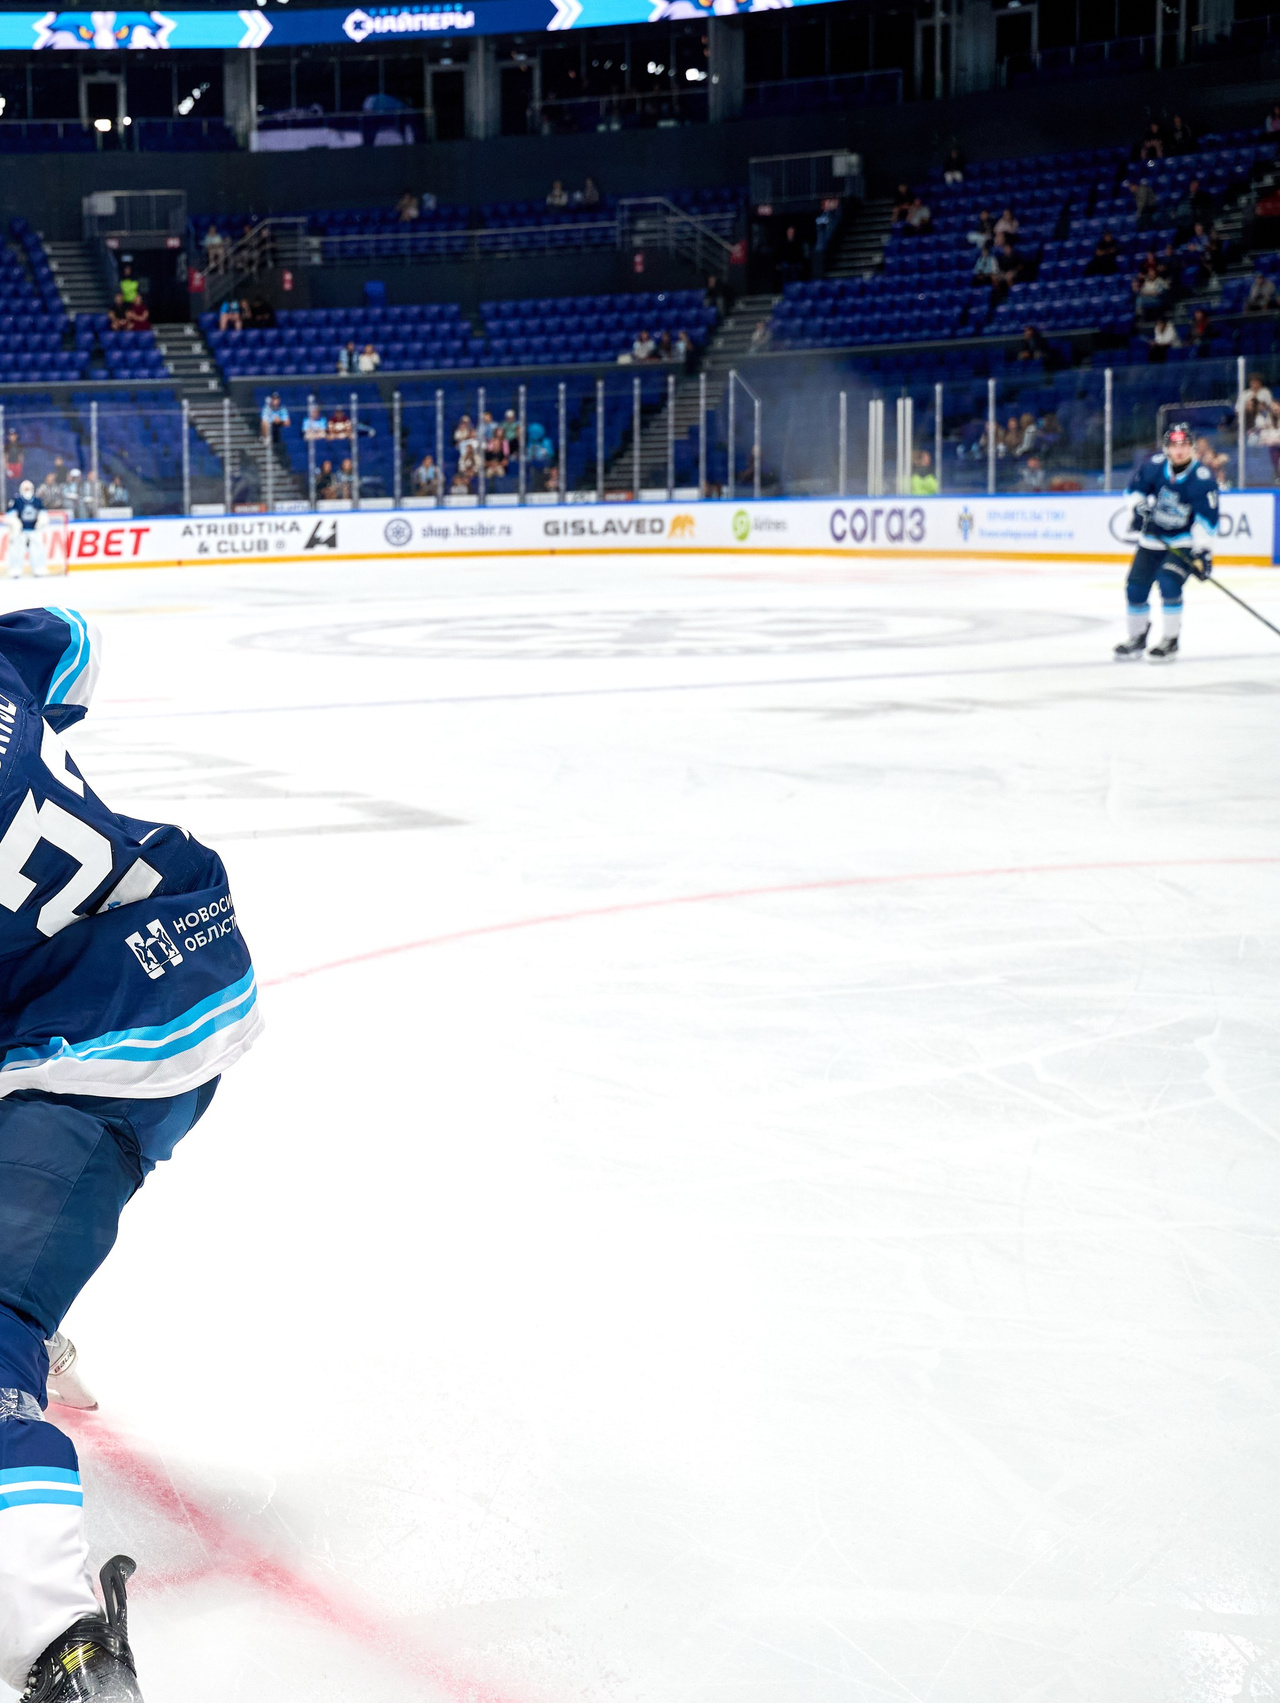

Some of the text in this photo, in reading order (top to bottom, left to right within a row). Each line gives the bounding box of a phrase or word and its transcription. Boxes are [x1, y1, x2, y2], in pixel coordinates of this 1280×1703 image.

[182, 521, 301, 537] ATRIBUTIKA
[543, 518, 665, 537] GISLAVED
[1218, 513, 1252, 540] DA
[217, 539, 269, 554] CLUB
[184, 914, 238, 952] ОБЛАСТ
